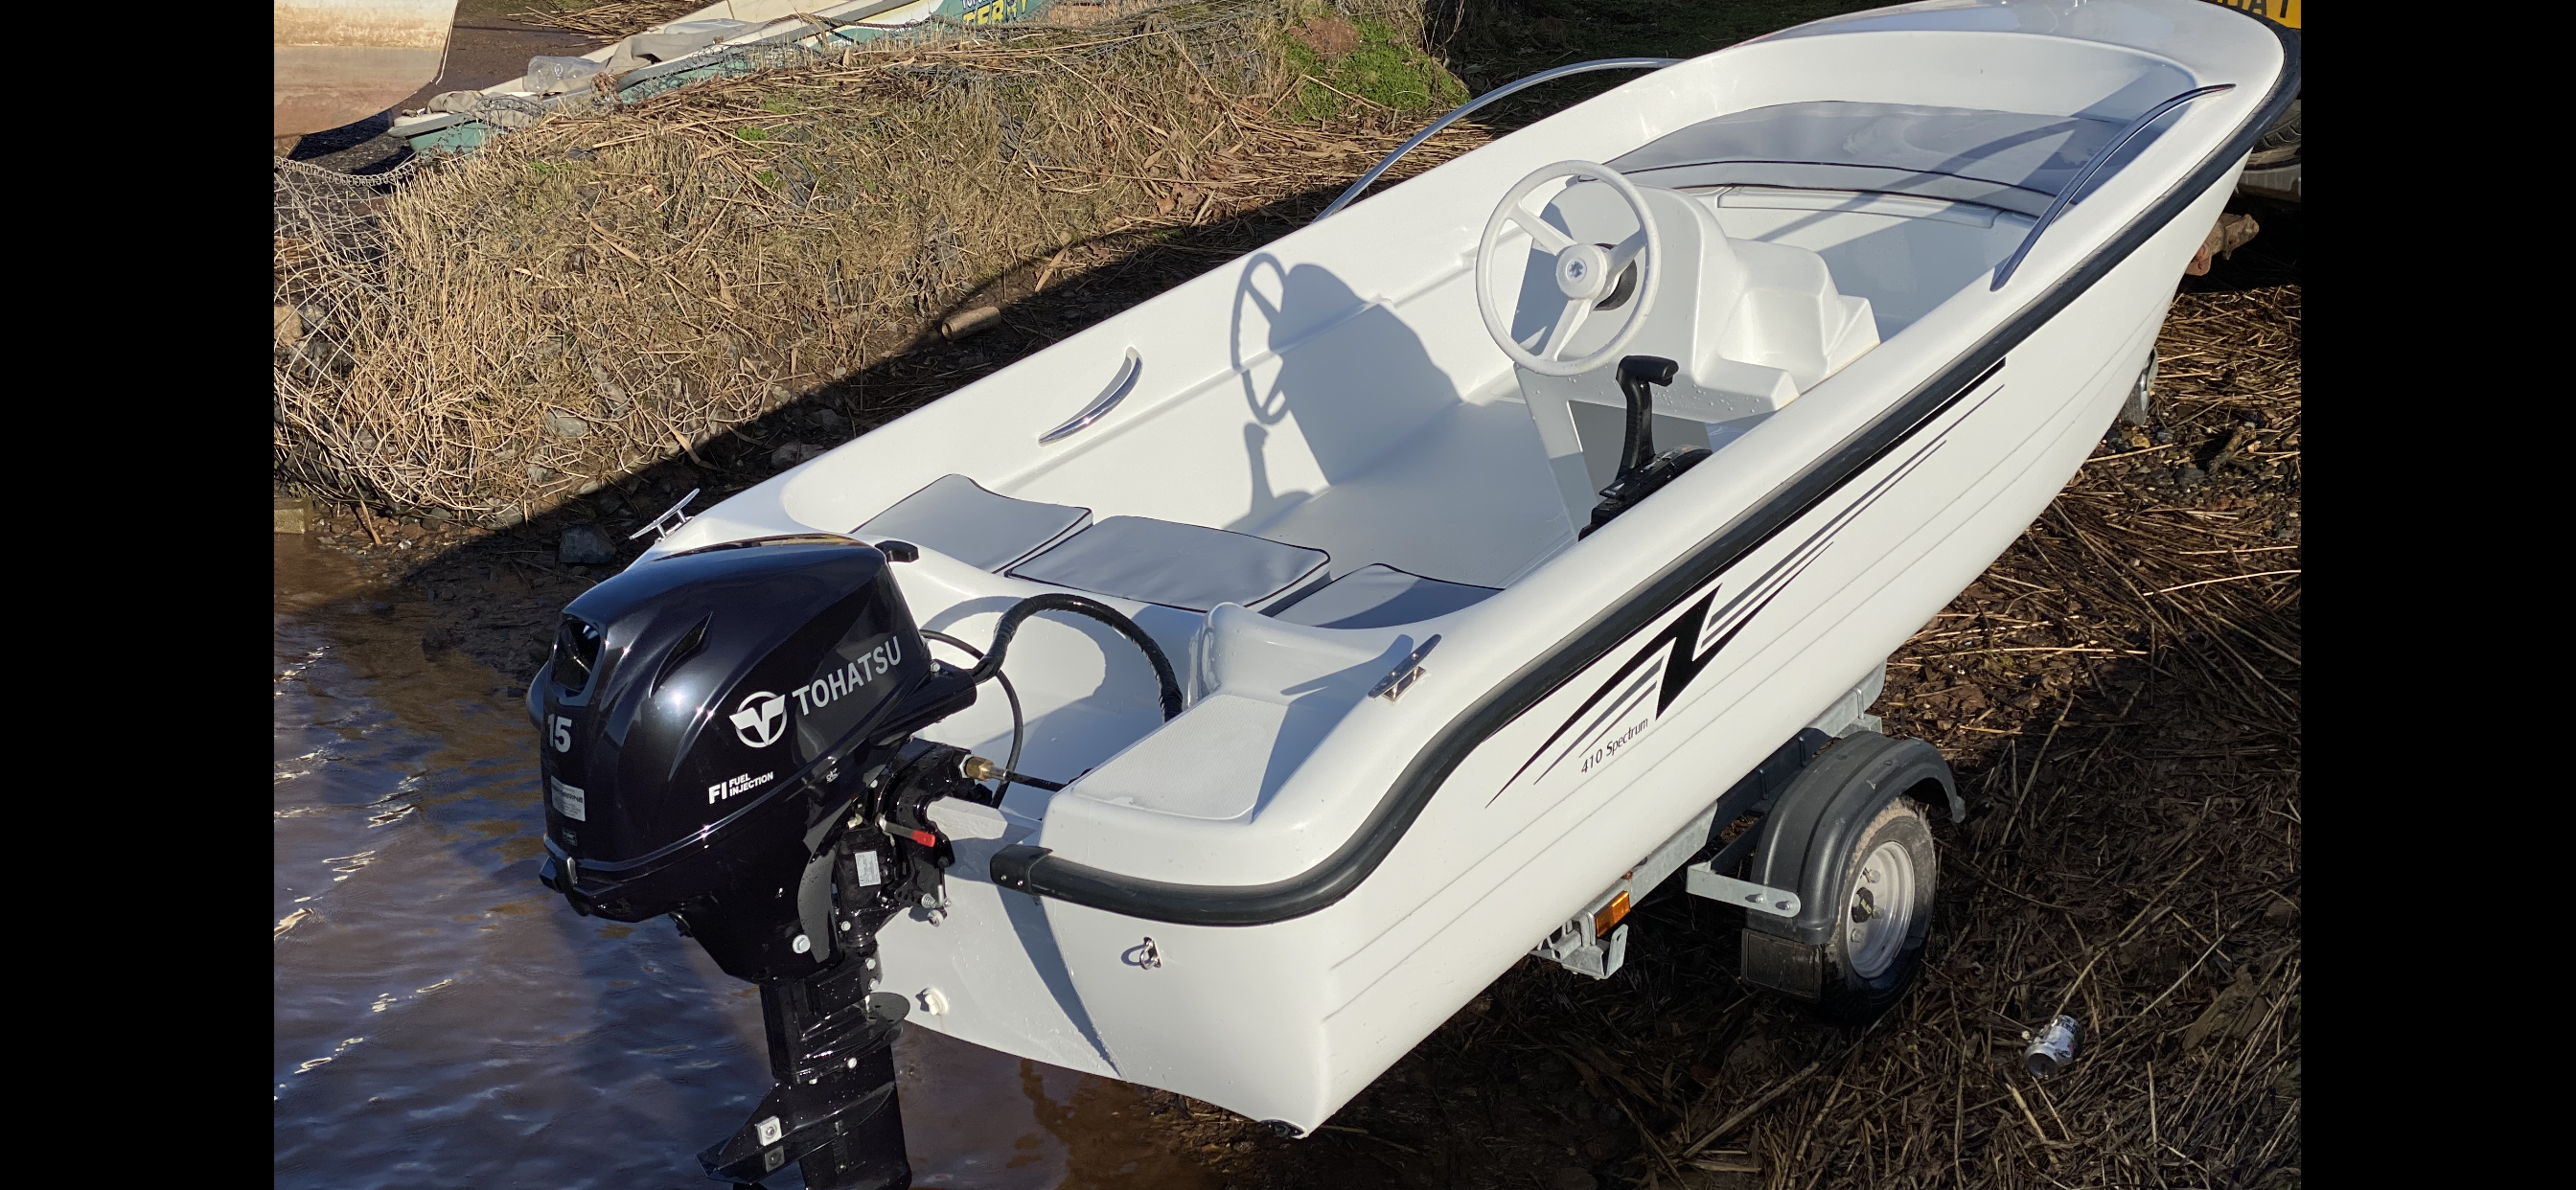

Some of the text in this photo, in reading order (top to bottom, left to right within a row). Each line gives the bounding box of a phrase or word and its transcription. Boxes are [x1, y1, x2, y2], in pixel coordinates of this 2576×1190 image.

[792, 635, 902, 717] TOHATSU
[547, 713, 572, 753] 15
[1581, 718, 1648, 773] 410 Spectrum
[708, 781, 728, 805] FI
[728, 773, 751, 789] FUEL
[729, 771, 774, 797] INJECTION
